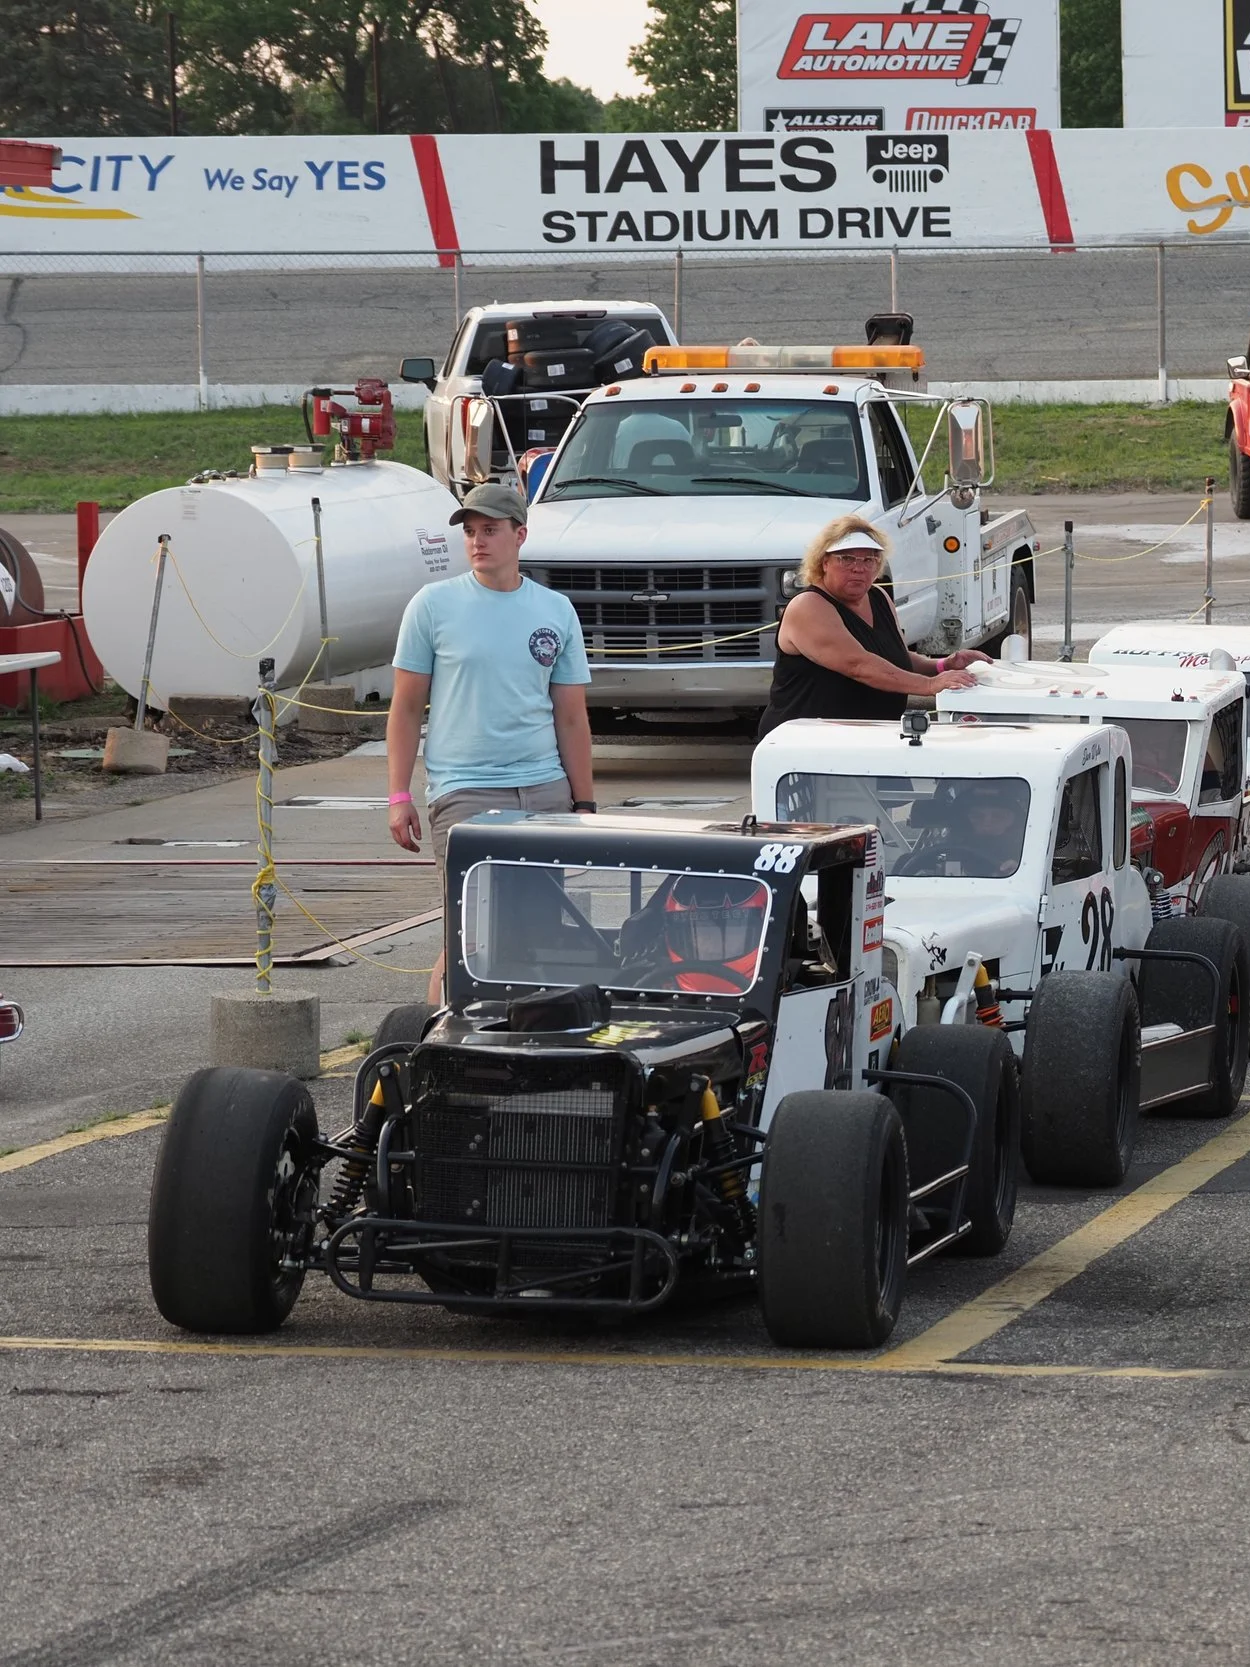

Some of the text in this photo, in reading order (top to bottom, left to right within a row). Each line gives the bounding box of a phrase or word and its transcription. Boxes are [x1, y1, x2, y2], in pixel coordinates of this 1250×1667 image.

[803, 22, 974, 51] LANE
[793, 55, 963, 72] AUTOMOTIVE
[789, 114, 879, 127] ALLSTAR
[539, 137, 837, 194] HAYES
[880, 139, 938, 162] Jeep
[52, 155, 175, 193] CITY
[204, 160, 386, 198] We Say YES
[542, 206, 952, 243] STADIUM DRIVE
[754, 843, 803, 873] 88
[1082, 886, 1114, 972] 28
